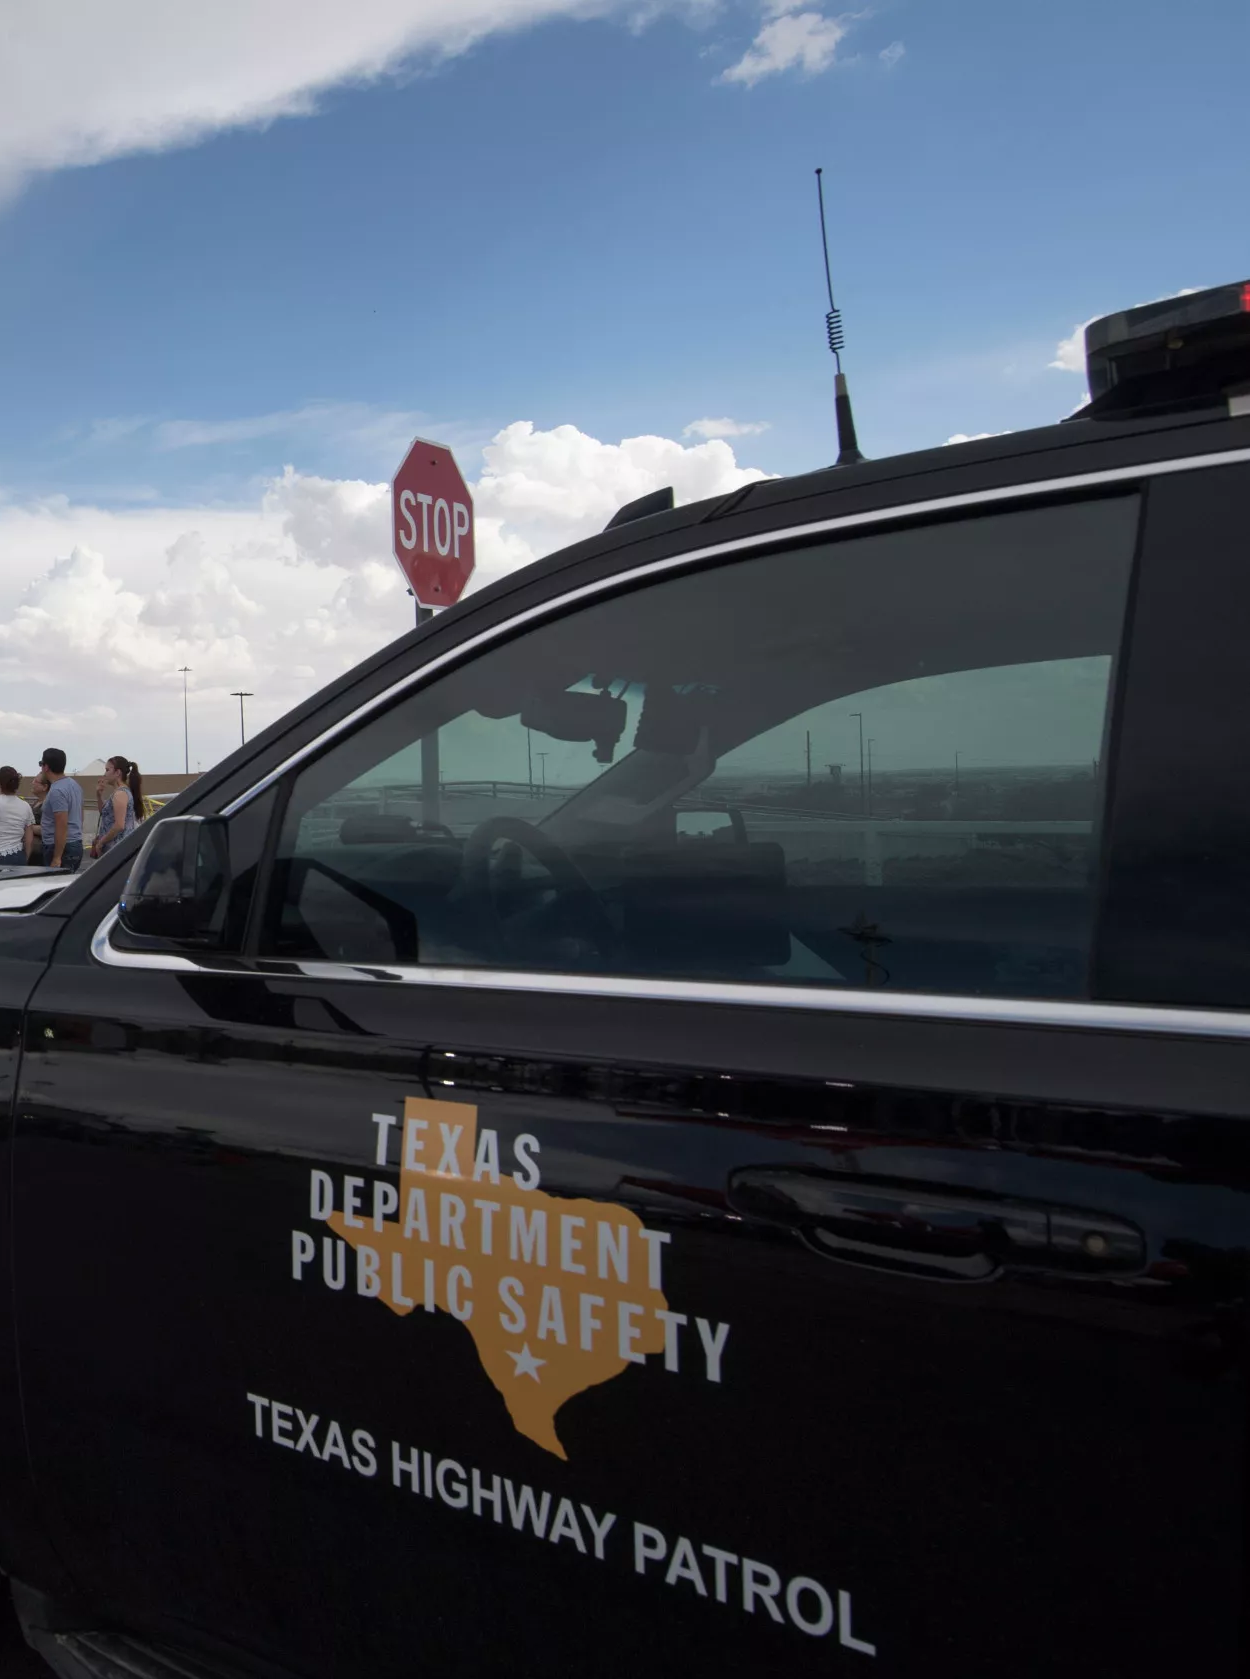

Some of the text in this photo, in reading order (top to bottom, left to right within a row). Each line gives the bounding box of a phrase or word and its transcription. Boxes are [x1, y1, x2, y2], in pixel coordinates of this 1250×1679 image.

[399, 489, 470, 559] STOP
[371, 1112, 542, 1192] TEXAS
[310, 1168, 672, 1290] DEPARTMENT
[291, 1230, 731, 1383] PUBLIC SAFETY
[246, 1391, 877, 1657] TEXAS HIGHWAY PATROL
